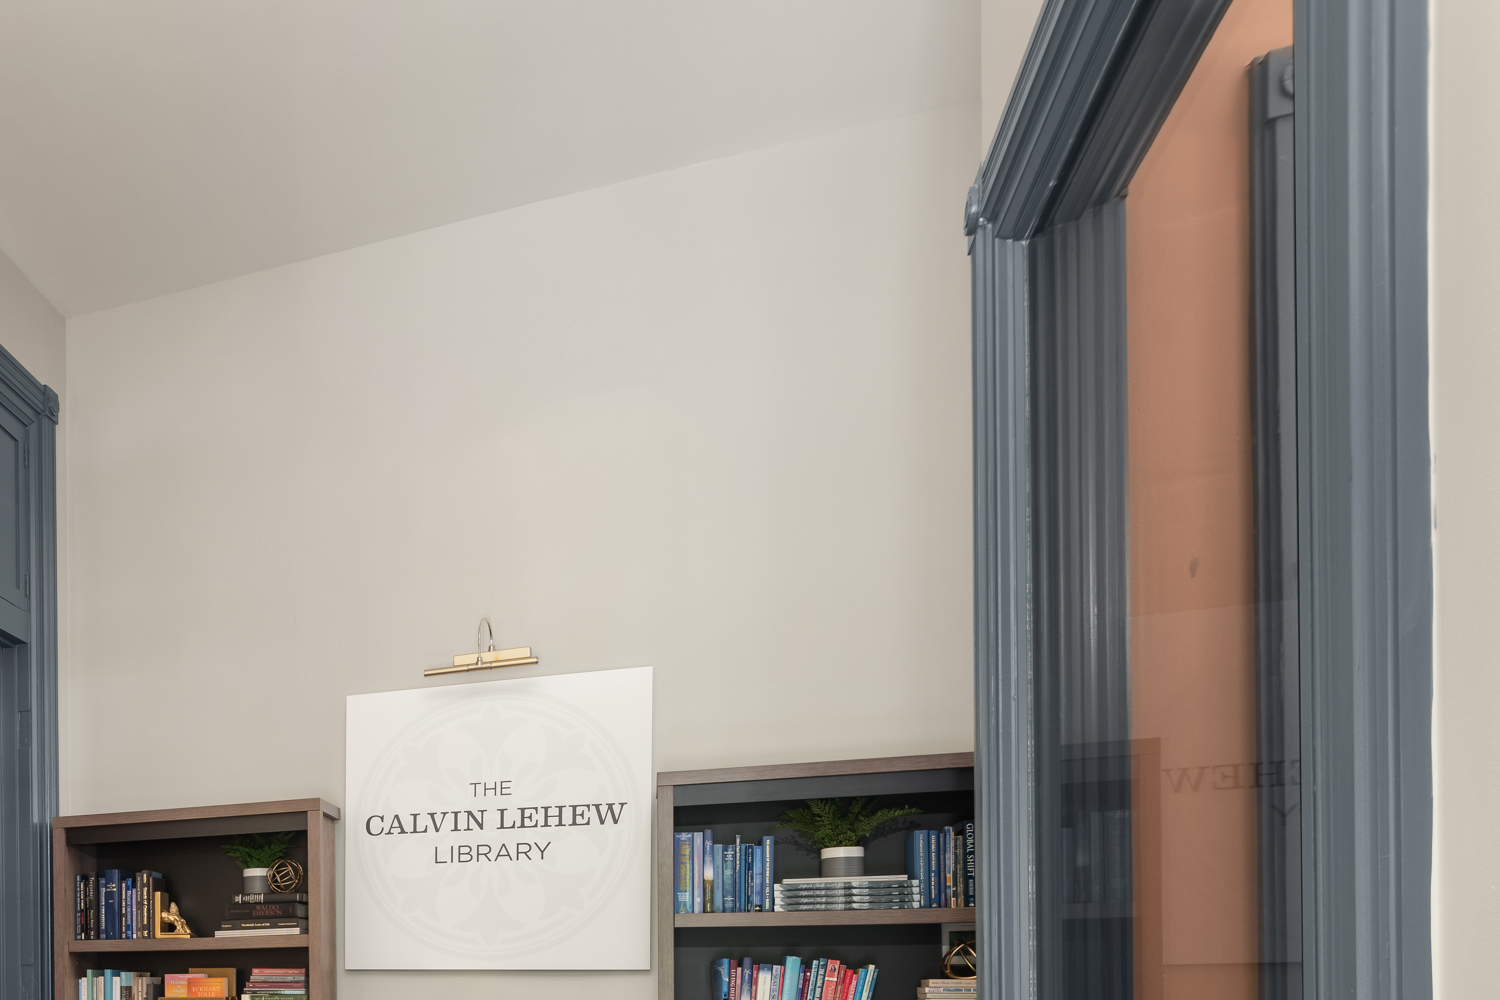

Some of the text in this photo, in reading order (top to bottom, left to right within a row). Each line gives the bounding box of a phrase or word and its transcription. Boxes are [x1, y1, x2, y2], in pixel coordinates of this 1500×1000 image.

[469, 780, 512, 797] THE
[365, 802, 627, 836] CALVIN LEHEW
[680, 842, 690, 854] LAW
[966, 823, 974, 853] GLOBAL
[434, 842, 551, 864] LIBRARY
[680, 864, 690, 891] SUCCESS
